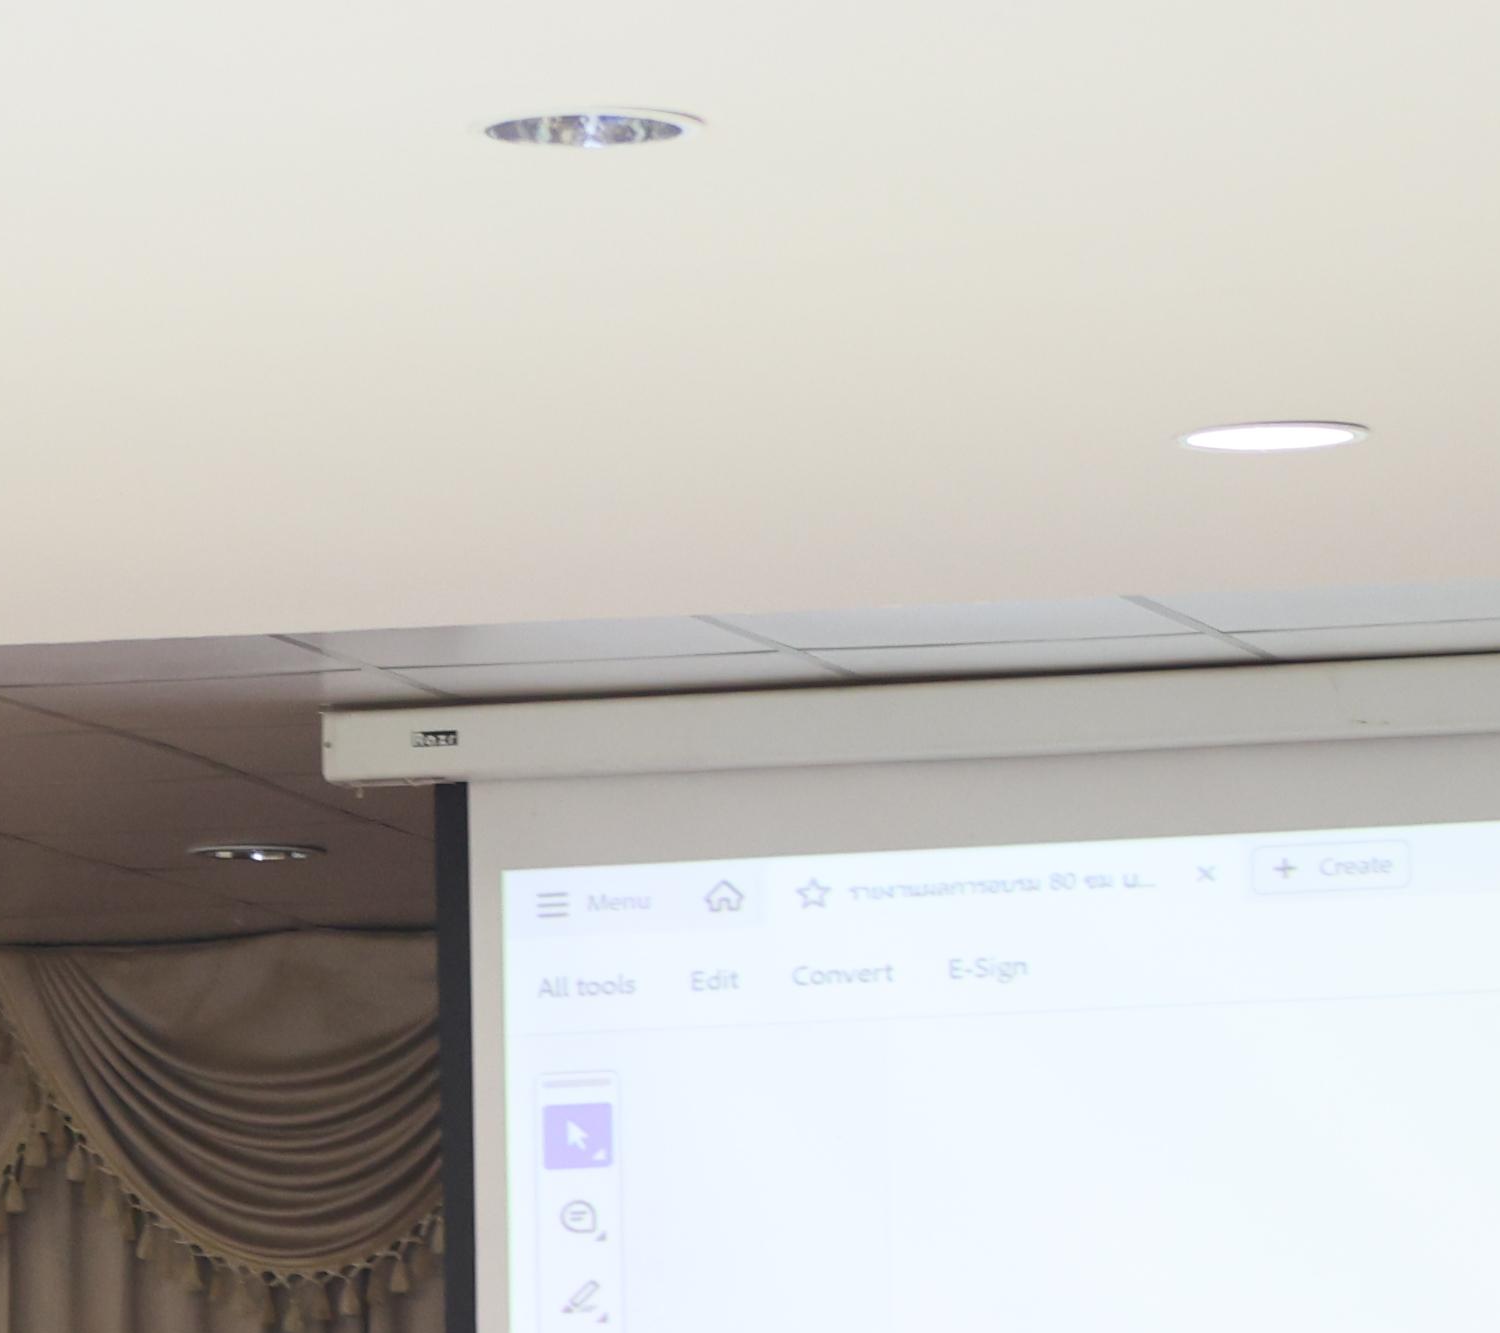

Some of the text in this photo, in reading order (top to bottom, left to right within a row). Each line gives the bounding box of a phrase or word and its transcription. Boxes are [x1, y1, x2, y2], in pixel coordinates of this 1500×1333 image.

[1318, 856, 1394, 878] Create
[1048, 871, 1077, 892] 80
[586, 893, 652, 913] Menu
[689, 969, 740, 993] Edit
[791, 963, 894, 987] Convert
[947, 956, 1028, 985] E-Sign
[537, 973, 637, 999] All tools
